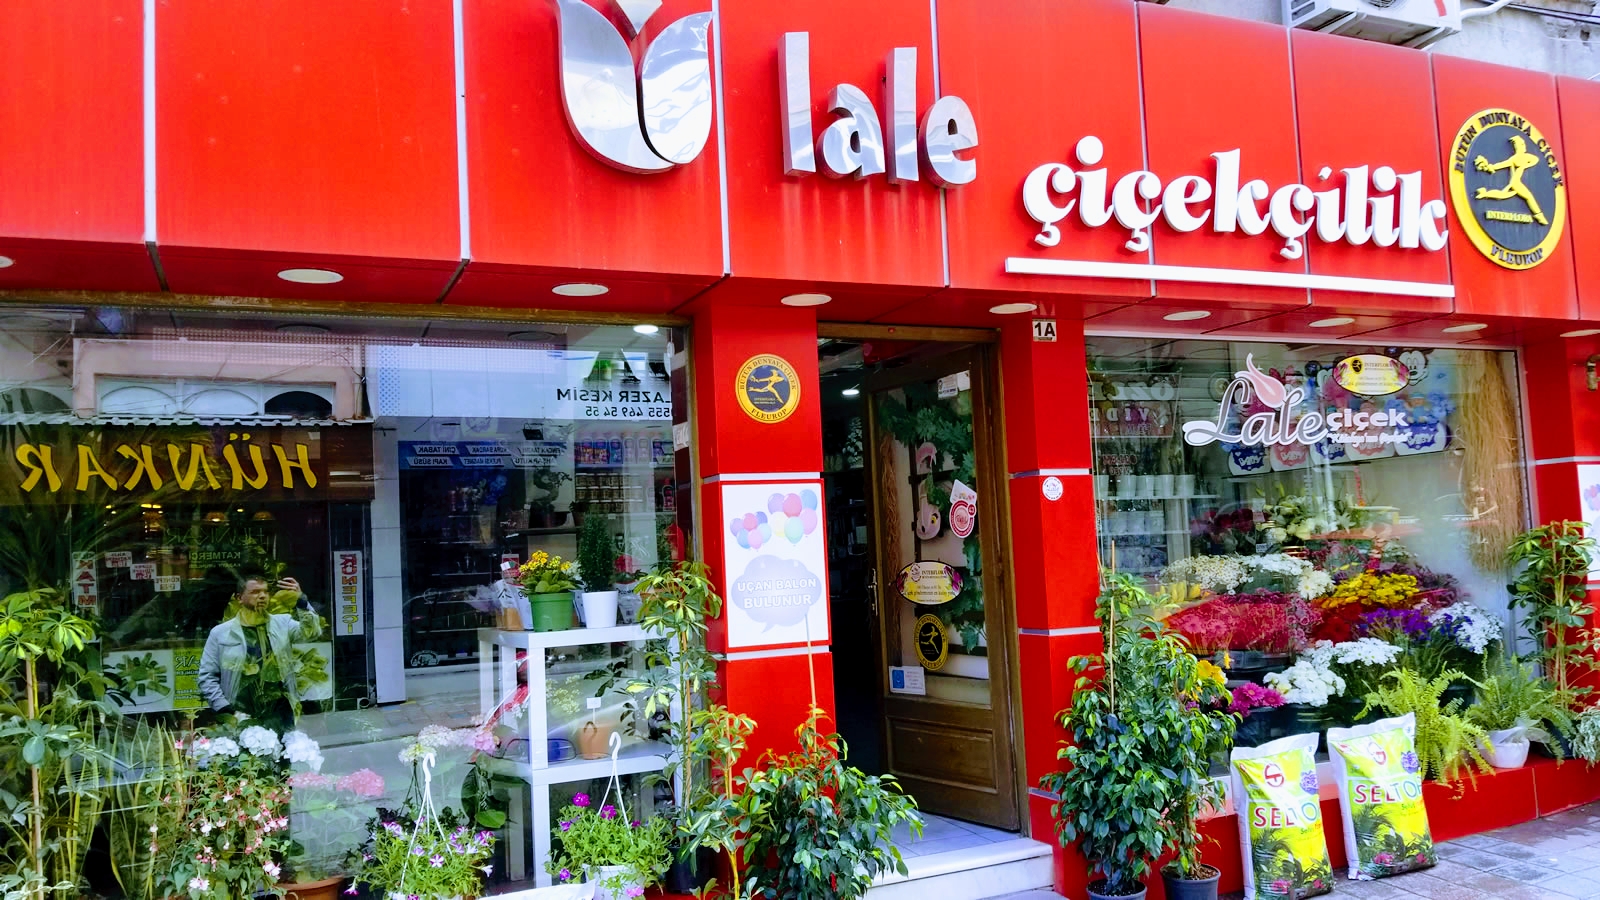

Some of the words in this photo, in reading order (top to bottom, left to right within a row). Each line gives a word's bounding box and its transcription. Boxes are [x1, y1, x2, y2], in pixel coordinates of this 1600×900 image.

[777, 31, 978, 189] lale
[1022, 135, 1449, 260] çiçekçilik
[1490, 244, 1544, 265] FLEUROP
[1035, 322, 1056, 337] 1A
[751, 408, 787, 420] FLEUROP
[1181, 371, 1328, 446] Lale
[1326, 408, 1409, 431] çiçek
[737, 580, 772, 594] UÇAN
[776, 578, 817, 590] BALON
[743, 594, 812, 609] BULUNUR
